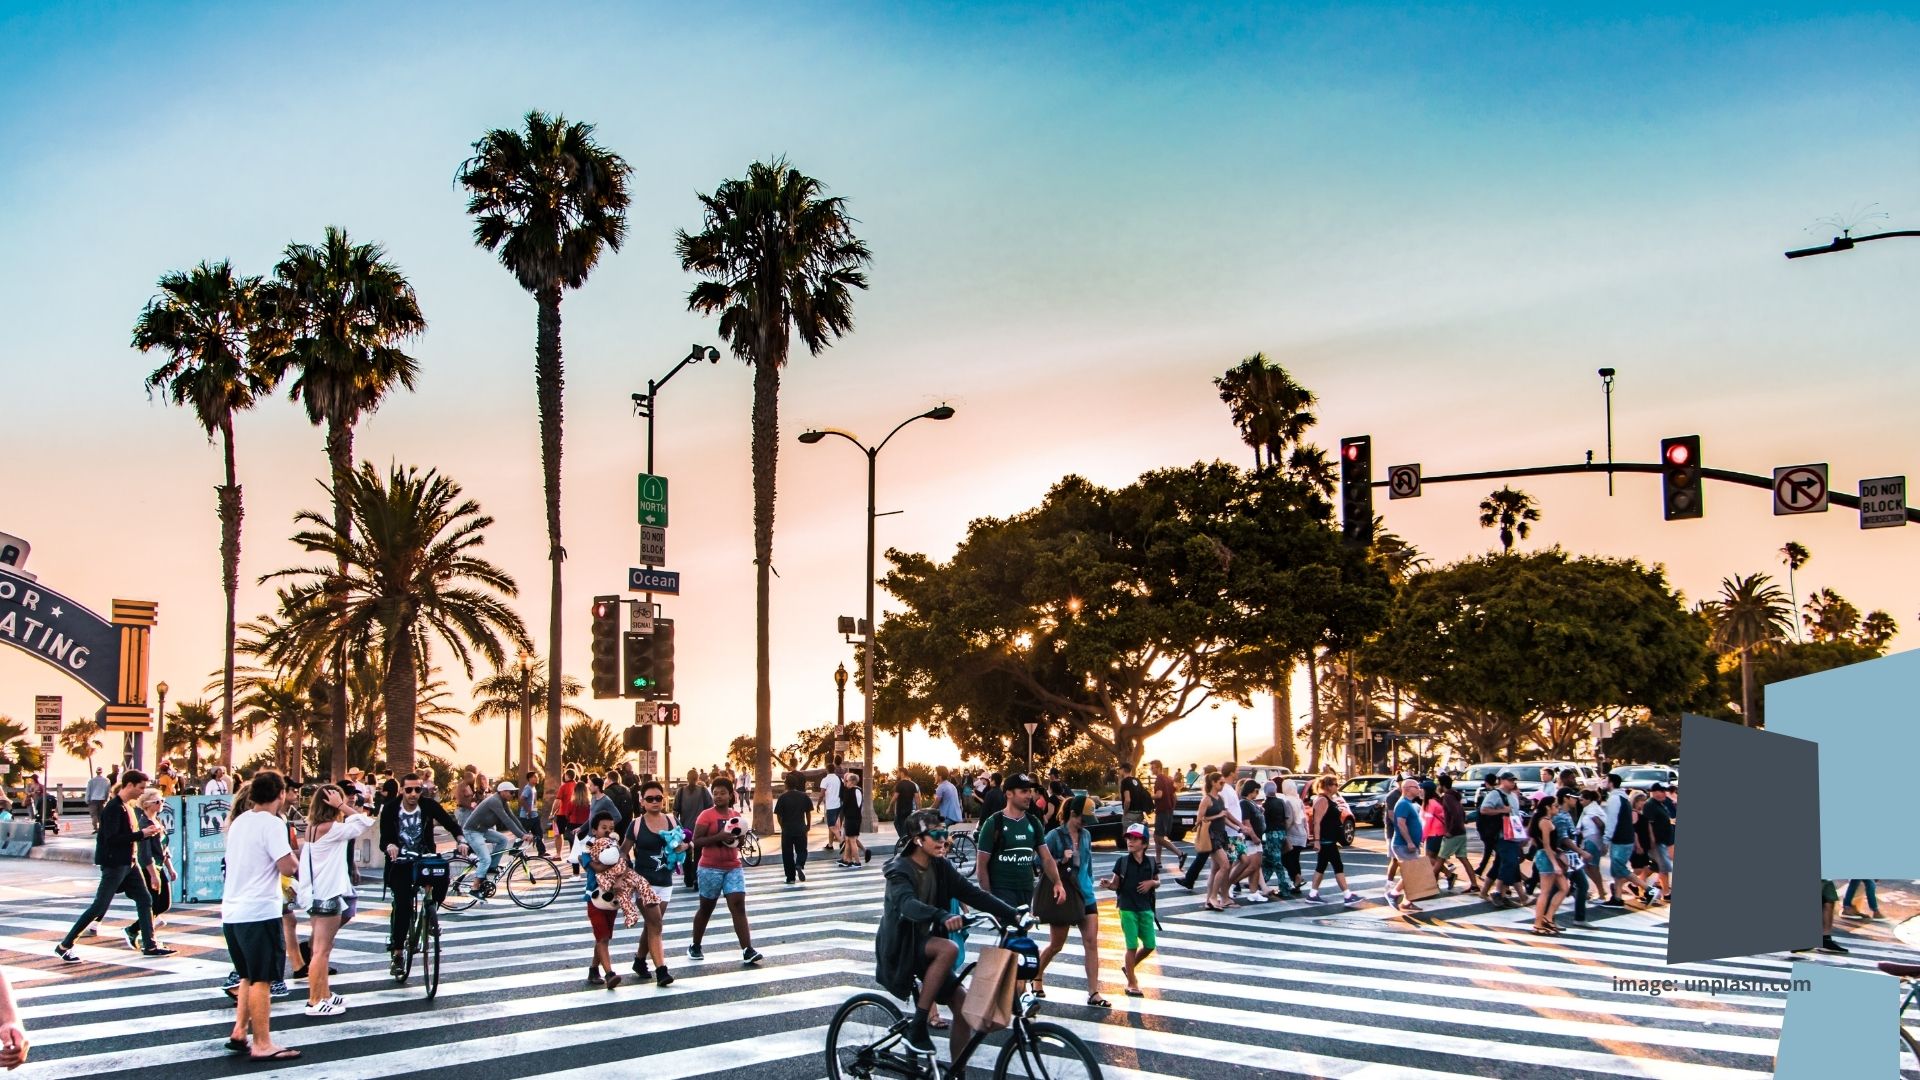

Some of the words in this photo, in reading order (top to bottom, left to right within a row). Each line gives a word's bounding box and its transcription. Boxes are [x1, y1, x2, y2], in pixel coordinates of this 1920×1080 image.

[1862, 485, 1878, 498] DO
[1880, 483, 1903, 496] NOT
[640, 501, 667, 514] NORTH
[1862, 499, 1903, 514] BLOCK
[641, 530, 651, 541] DO
[651, 532, 664, 543] NOT
[641, 543, 665, 555] BLOCK
[633, 571, 676, 588] Ocean
[632, 621, 653, 629] SIGNAL
